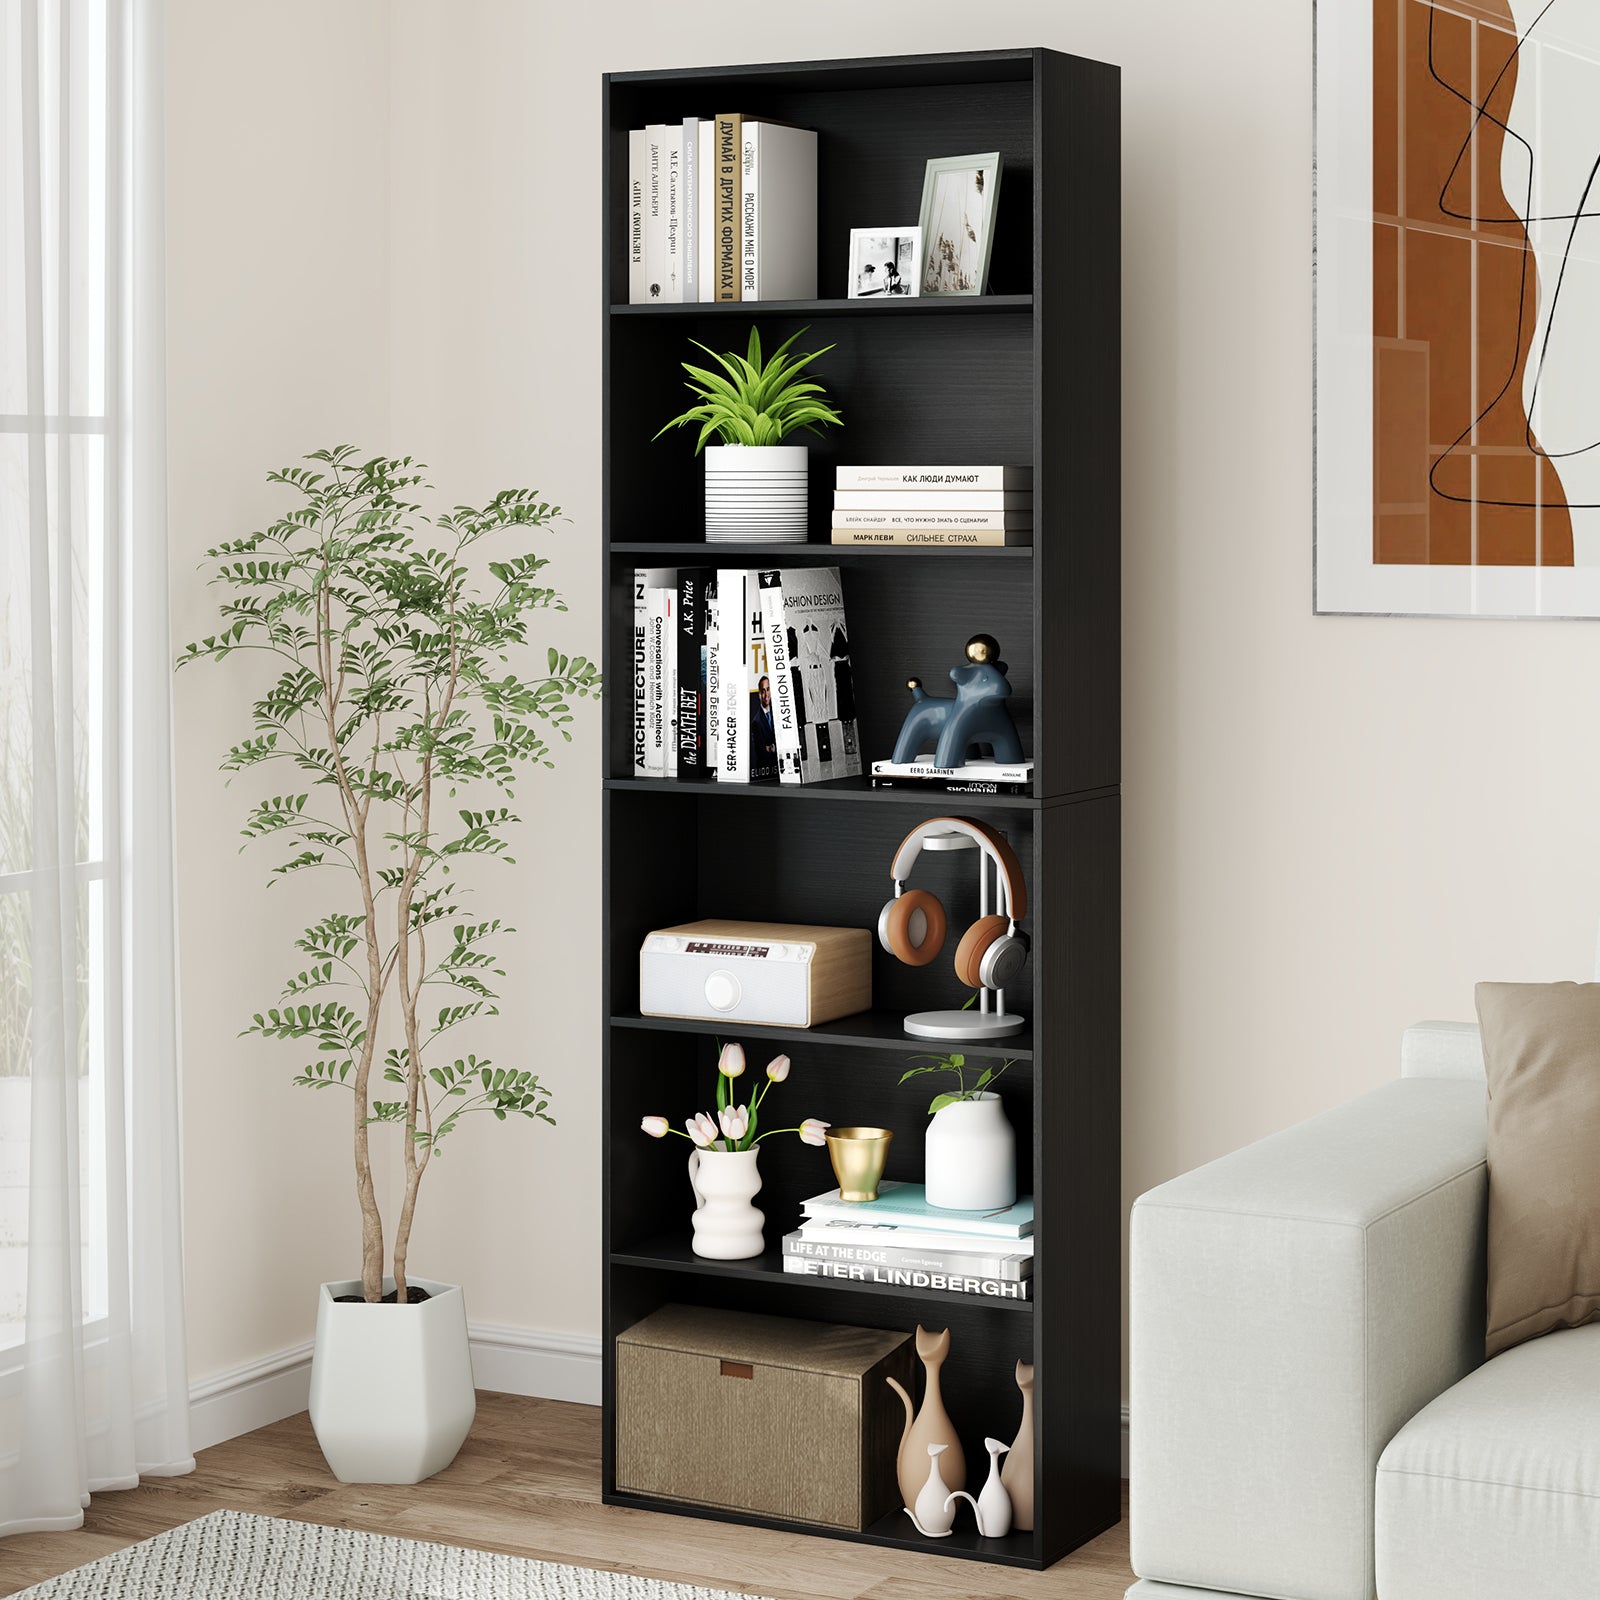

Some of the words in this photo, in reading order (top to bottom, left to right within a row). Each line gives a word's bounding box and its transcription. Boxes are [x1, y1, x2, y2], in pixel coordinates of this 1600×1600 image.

[651, 143, 659, 172] ДАНТЕ
[720, 121, 736, 162] ДУМАЙ
[722, 166, 733, 174] В
[633, 179, 642, 208] МИРУ
[651, 173, 659, 217] АЛИГЬЕРИ
[720, 178, 733, 223] ДРУГИХ
[633, 211, 642, 255] ВЕЧНОМУ
[745, 192, 755, 237] РАССКАЖИ
[721, 226, 733, 288] ФОРМАТАХ
[745, 239, 755, 257] МНЕ
[745, 267, 755, 291] МОРЕ
[902, 475, 918, 483] КАК
[918, 475, 943, 484] ЛЮДИ
[944, 475, 979, 484] ДУМАЮТ
[906, 534, 944, 543] СИЛЬНЕЕ
[947, 534, 978, 543] СТРАХА
[683, 580, 694, 606] Price
[783, 595, 812, 608] ASHION
[813, 593, 841, 606] DESIGN
[683, 610, 694, 636] A.K.
[655, 616, 663, 679] Conversations
[771, 624, 786, 670] DESIGN
[709, 646, 717, 694] FASHION
[635, 626, 646, 768] ARCHITECTURE
[655, 682, 663, 701] with
[681, 686, 697, 710] BET
[776, 675, 792, 730] FASHION
[655, 703, 663, 748] Architects
[681, 711, 697, 750] DEATH
[709, 697, 717, 736] DESIGN
[684, 751, 697, 765] the
[790, 1241, 813, 1254] LIFE
[815, 1245, 828, 1257] AT
[832, 1246, 854, 1259] THE
[856, 1248, 887, 1263] EDGE
[788, 1257, 865, 1280] PETER
[873, 1268, 1018, 1298] LINDBERGH
